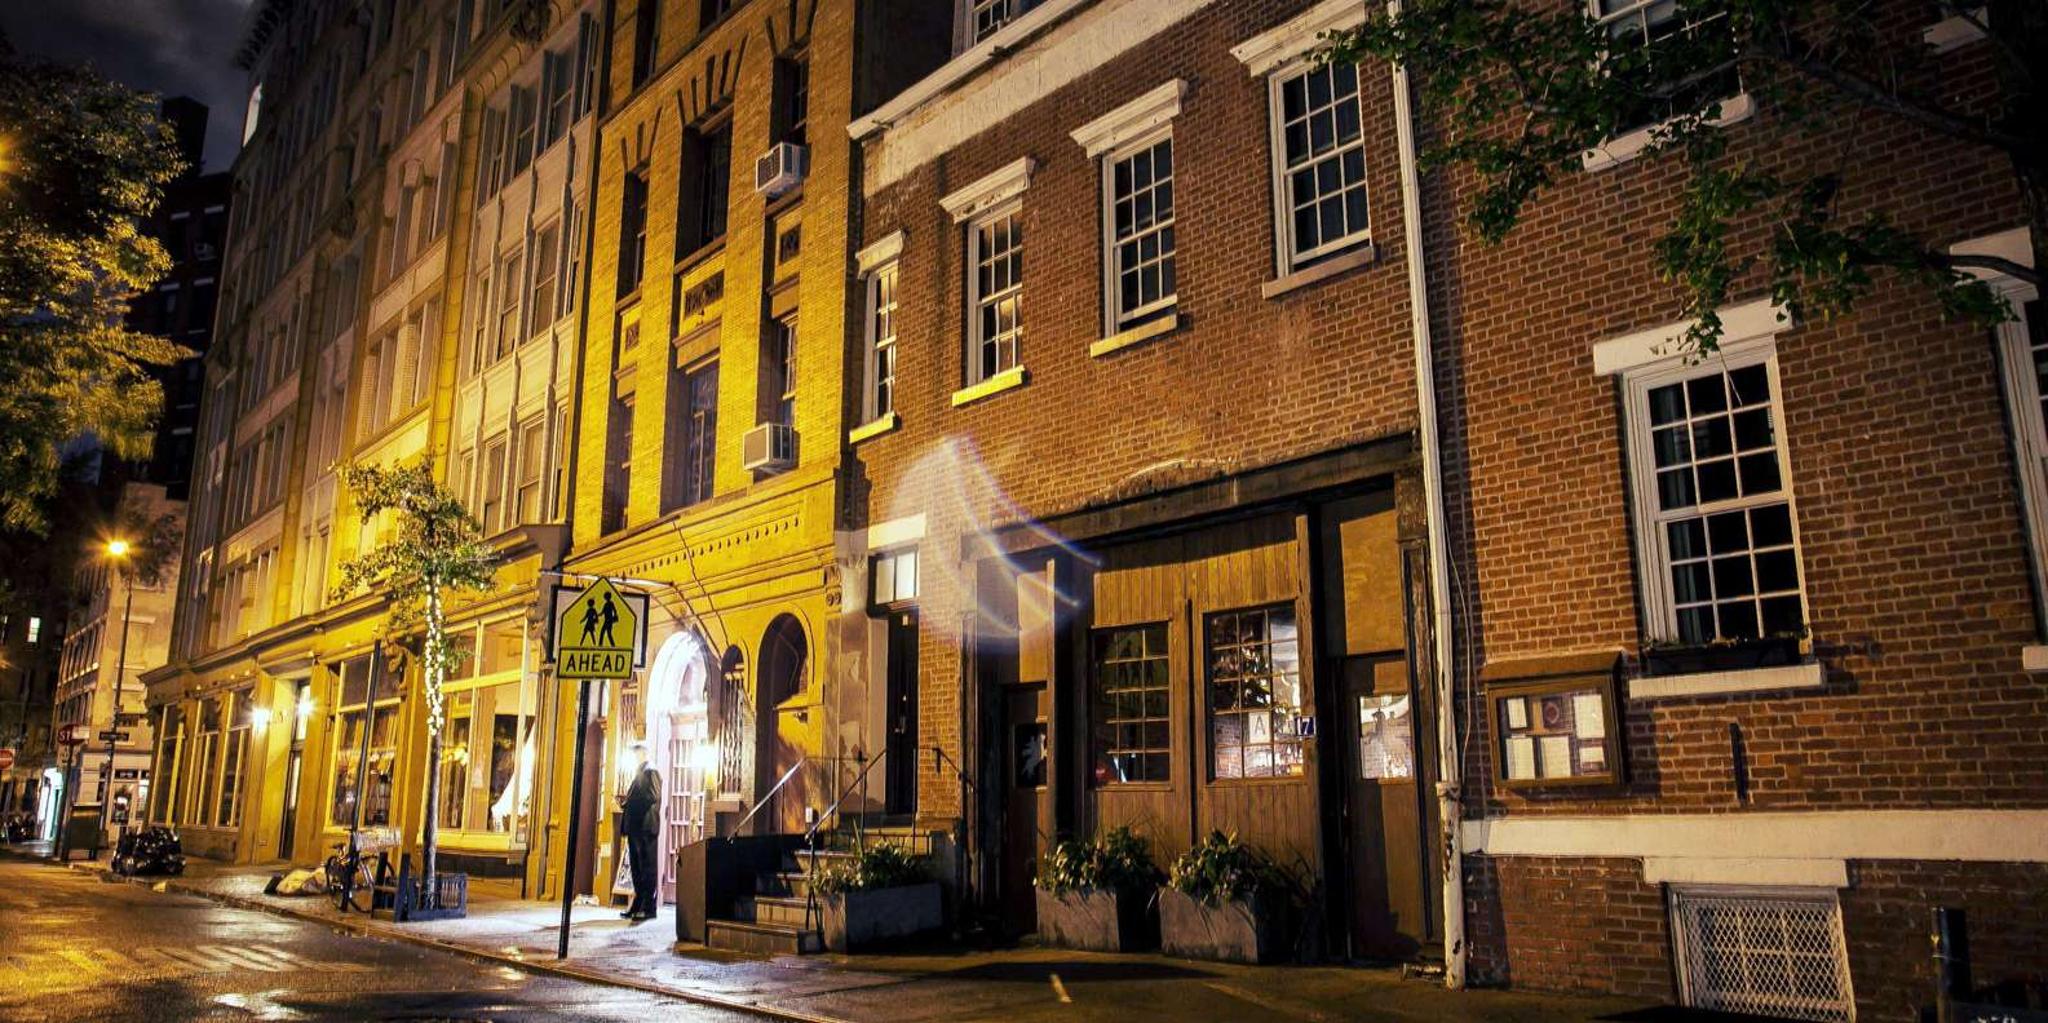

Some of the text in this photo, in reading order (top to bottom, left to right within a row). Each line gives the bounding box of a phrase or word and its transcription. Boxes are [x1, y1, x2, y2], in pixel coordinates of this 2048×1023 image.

[566, 654, 624, 672] AHEAD
[1255, 714, 1266, 735] A
[1296, 717, 1310, 735] 17
